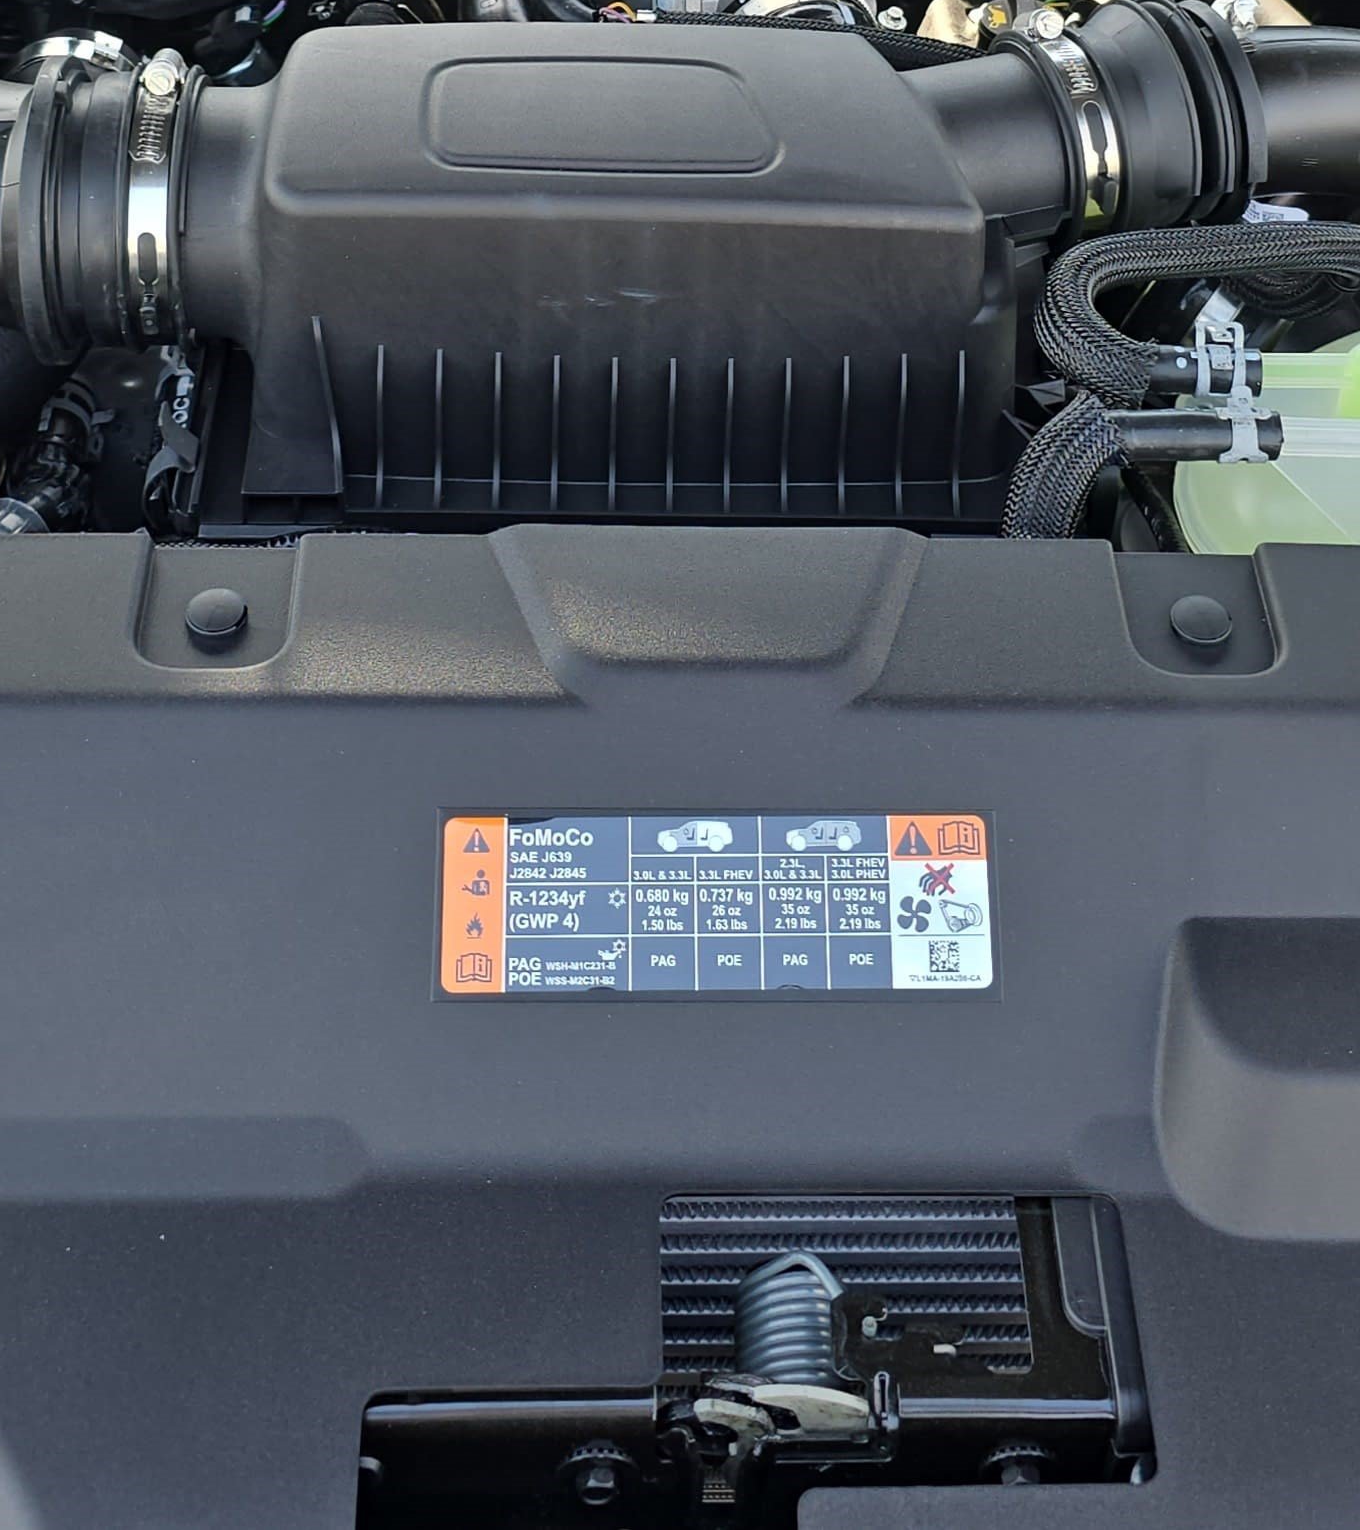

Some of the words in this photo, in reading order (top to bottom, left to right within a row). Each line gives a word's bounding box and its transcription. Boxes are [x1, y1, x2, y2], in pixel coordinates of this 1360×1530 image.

[509, 828, 594, 846] FoMoCo
[510, 851, 538, 863] SAE
[542, 851, 573, 863] J639
[831, 858, 854, 868] 3.3L
[855, 858, 885, 868] FHEV
[509, 867, 547, 879] J2842
[549, 867, 587, 879] J2845
[633, 870, 656, 880] 3.0L
[658, 870, 667, 880] &
[668, 870, 692, 880] 3.3L
[698, 870, 722, 880] 3.3L
[723, 870, 753, 880] FHEV
[763, 870, 787, 879] 3.0L
[788, 870, 797, 879] &
[799, 870, 822, 879] 3.3L
[831, 869, 854, 879] 3.0L
[855, 869, 886, 879] PHEV
[509, 890, 587, 909] R-1234yf
[635, 888, 670, 903] 0.680
[673, 888, 689, 905] kg
[699, 888, 733, 903] 0.737
[736, 888, 753, 905] kg
[768, 887, 803, 901] 0.992
[805, 887, 822, 904] kg
[832, 887, 867, 902] 0.992
[870, 887, 886, 904] kg
[647, 905, 661, 916] 24
[663, 907, 678, 916] oz
[711, 904, 726, 916] 26
[727, 907, 741, 916] oz
[781, 903, 795, 915] 35
[796, 905, 811, 915] oz
[845, 903, 859, 915] 35
[861, 906, 875, 915] oz
[509, 913, 559, 932] (GWP
[562, 913, 580, 932] 4)
[641, 919, 664, 930] 1.50
[666, 919, 684, 930] lbs
[706, 919, 728, 930] 1.63
[730, 919, 748, 930] lbs
[774, 917, 798, 929] 2.19
[800, 917, 817, 929] lbs
[839, 918, 862, 929] 2.19
[864, 918, 881, 929] lbs
[508, 957, 542, 971] PAG
[650, 954, 677, 967] PAG
[717, 954, 742, 967] POE
[782, 954, 809, 966] PAG
[849, 953, 874, 966] POE
[508, 971, 542, 986] POE
